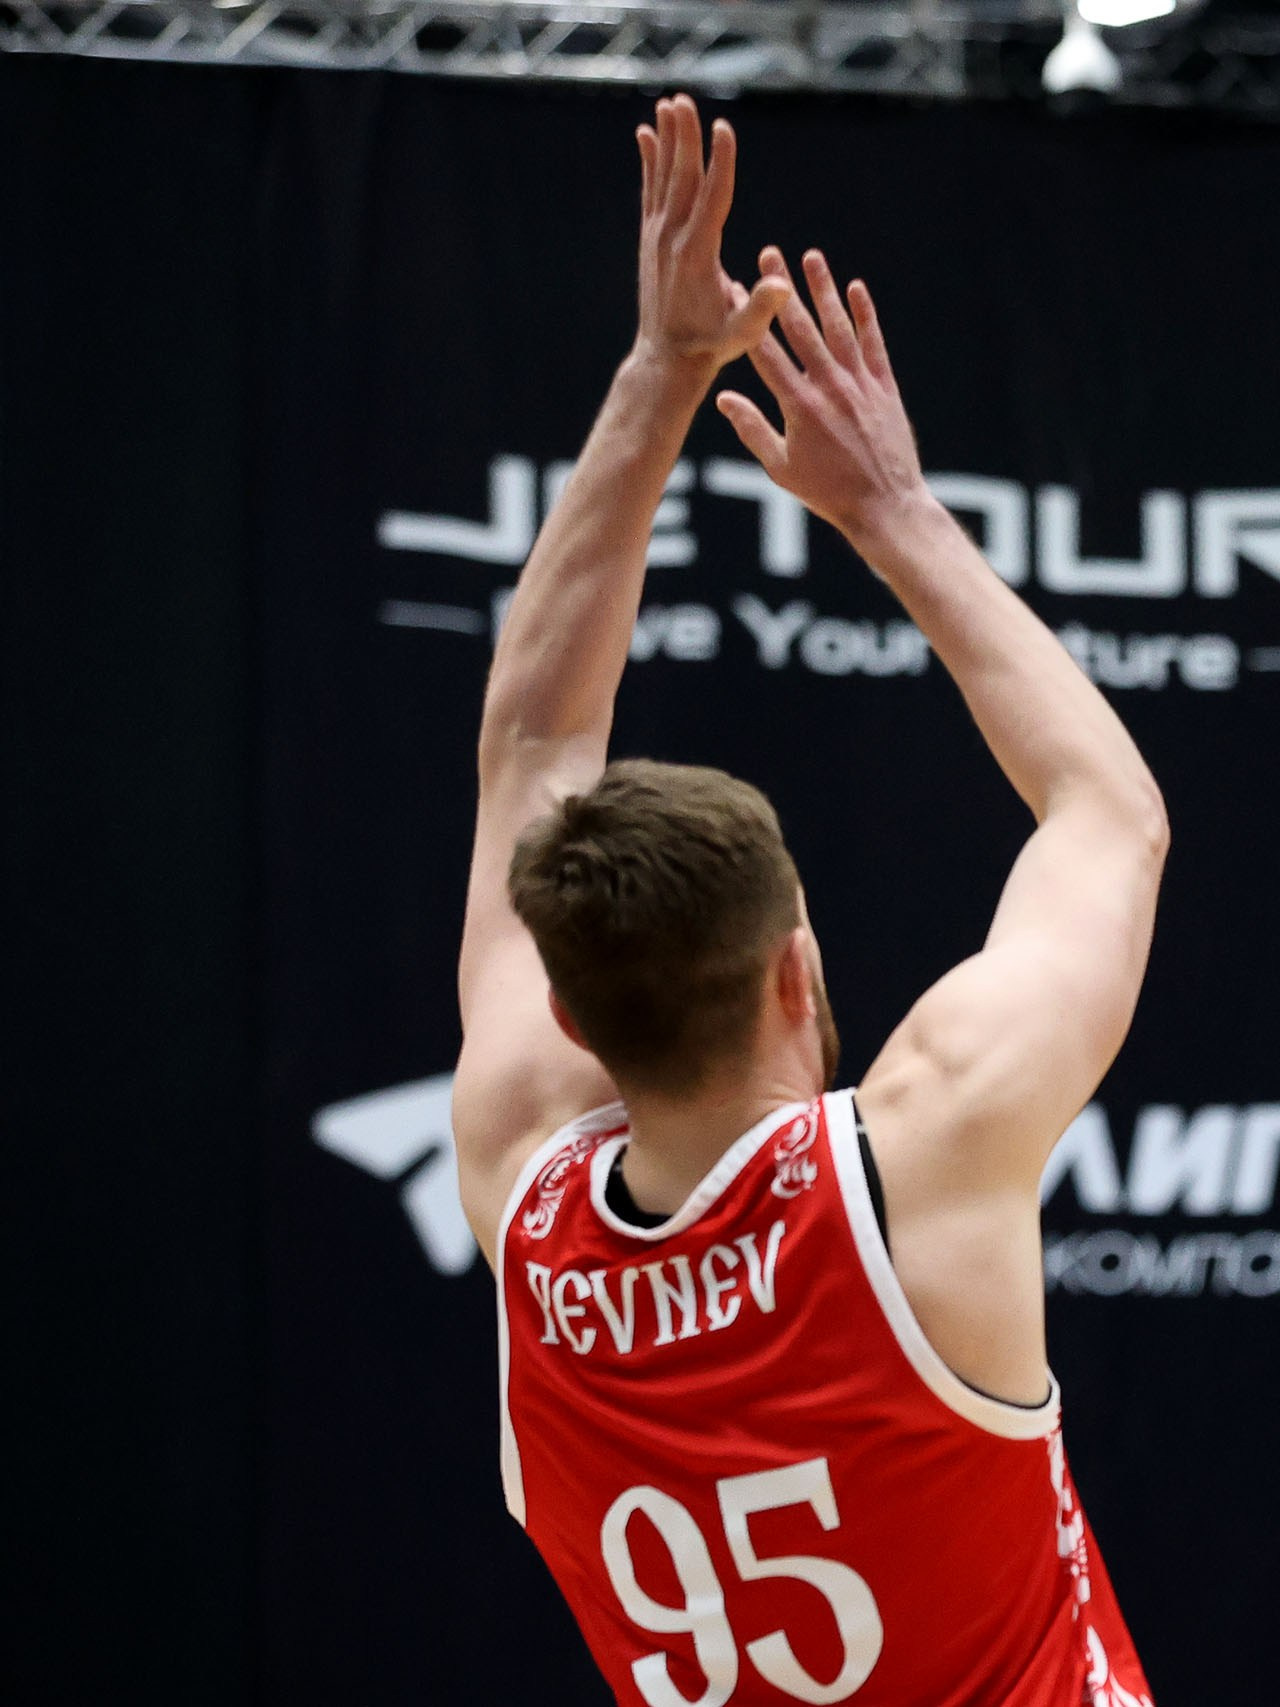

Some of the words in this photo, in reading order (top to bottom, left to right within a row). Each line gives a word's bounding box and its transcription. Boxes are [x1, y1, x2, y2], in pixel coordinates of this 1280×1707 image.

[733, 593, 932, 676] Your
[525, 1219, 787, 1355] PEVNEV
[600, 1457, 885, 1707] 95
